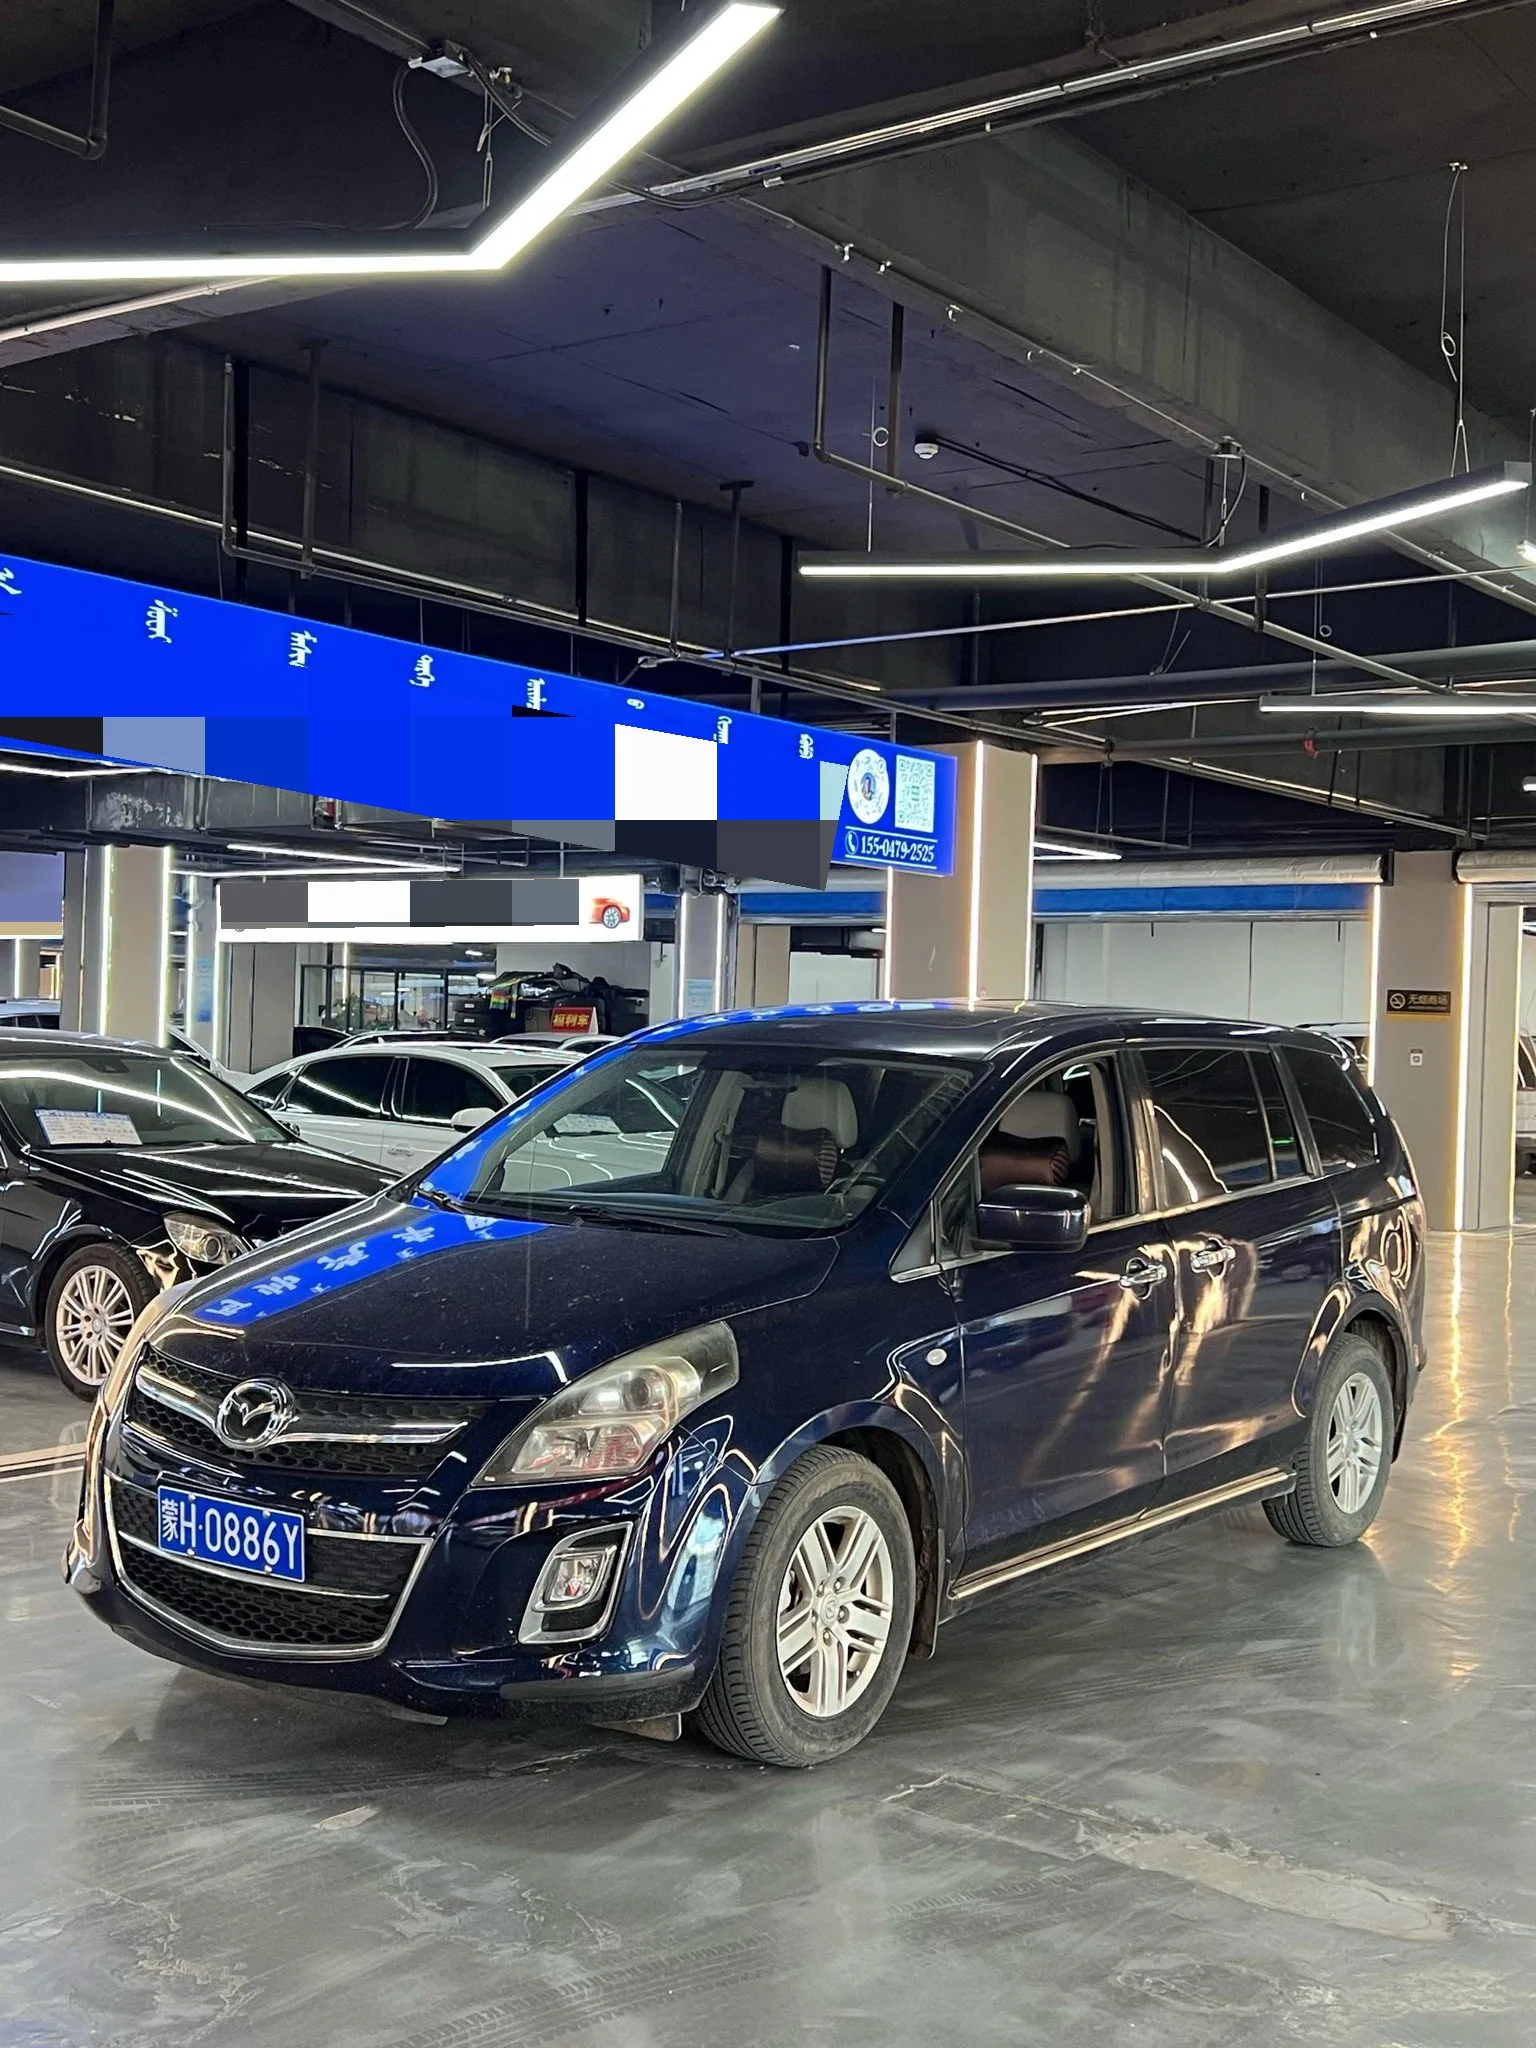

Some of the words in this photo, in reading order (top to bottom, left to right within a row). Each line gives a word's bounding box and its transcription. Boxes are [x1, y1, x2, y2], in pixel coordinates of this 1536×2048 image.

[861, 835, 935, 863] 155-0479-2525
[553, 1013, 590, 1027] 福利车
